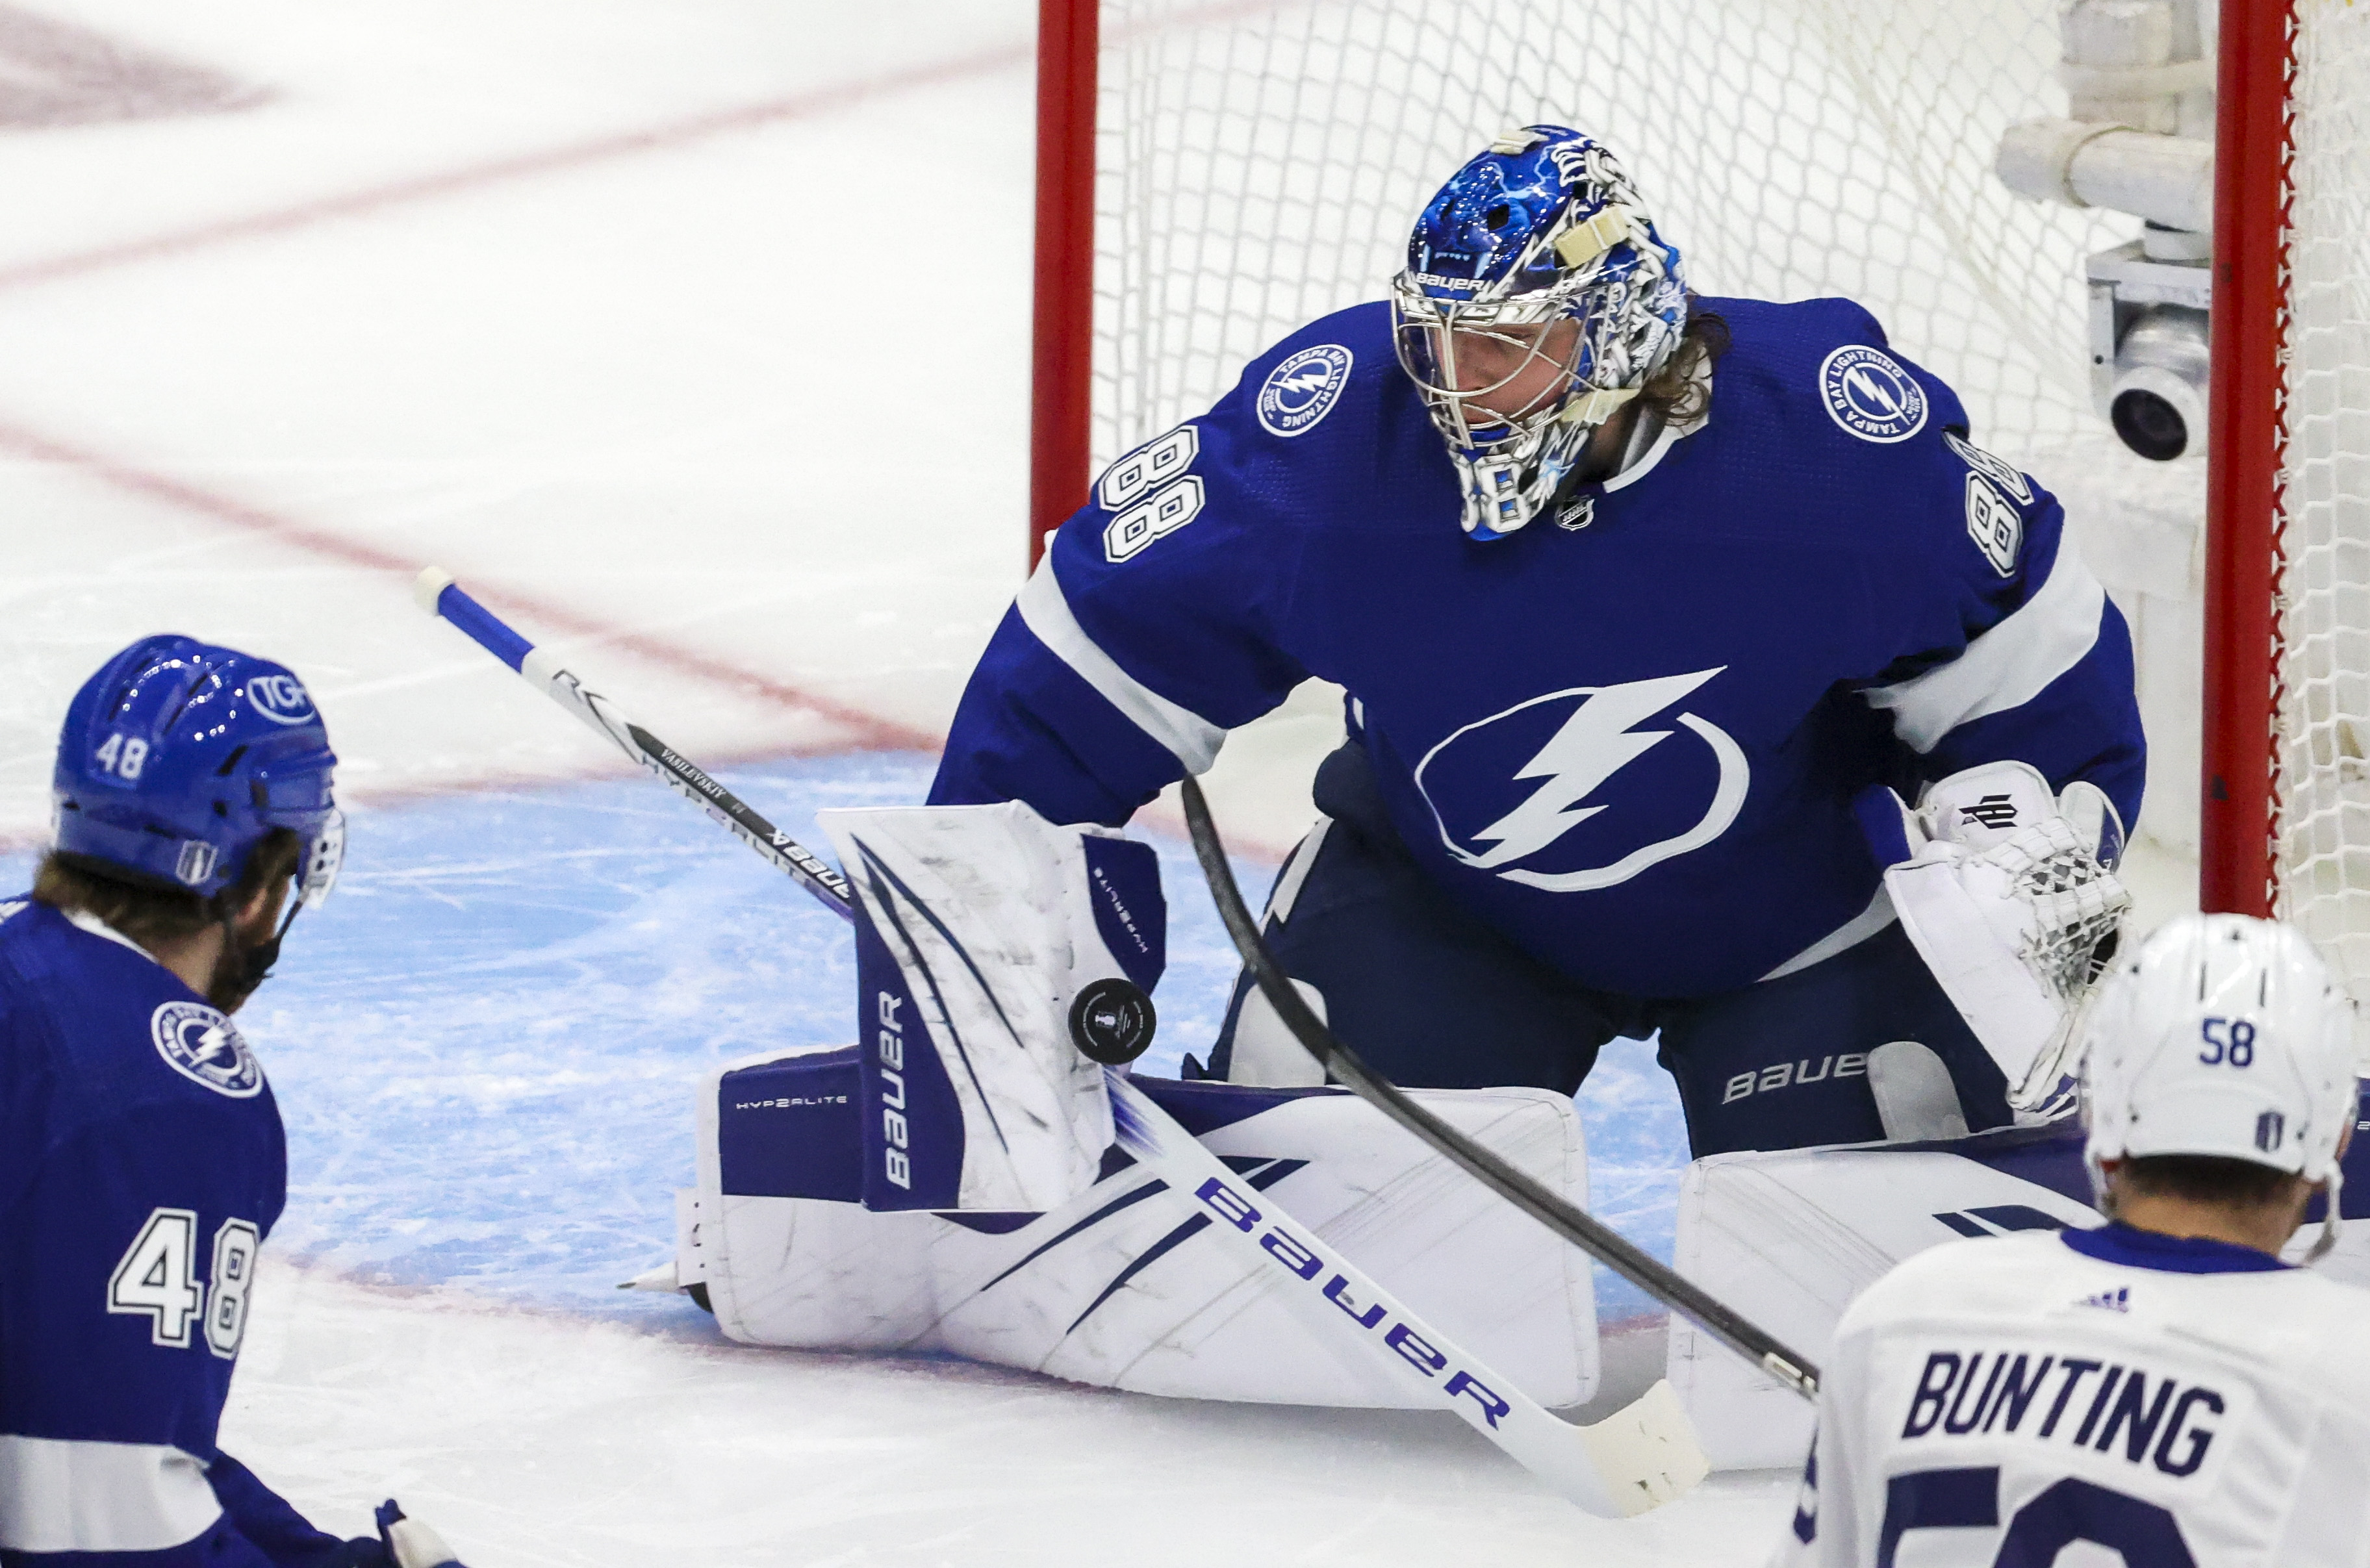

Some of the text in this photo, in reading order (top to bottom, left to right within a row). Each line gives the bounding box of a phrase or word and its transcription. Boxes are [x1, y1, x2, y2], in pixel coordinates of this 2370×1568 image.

[1416, 272, 1486, 292] BAUER
[1828, 351, 1902, 435] TAMPA BAY LIGHTNING
[1098, 425, 1205, 563] 88
[1941, 431, 2033, 578] 88
[96, 731, 149, 779] 48
[659, 748, 727, 800] VASILEVSKIY
[783, 844, 850, 899] BAUE
[1722, 1052, 1869, 1105] BAUE
[2199, 1018, 2255, 1067] 58
[878, 991, 911, 1190] BAUER
[107, 1207, 260, 1361] 48
[1194, 1176, 1511, 1430] BAUER
[1900, 1352, 2225, 1478] BUNTING
